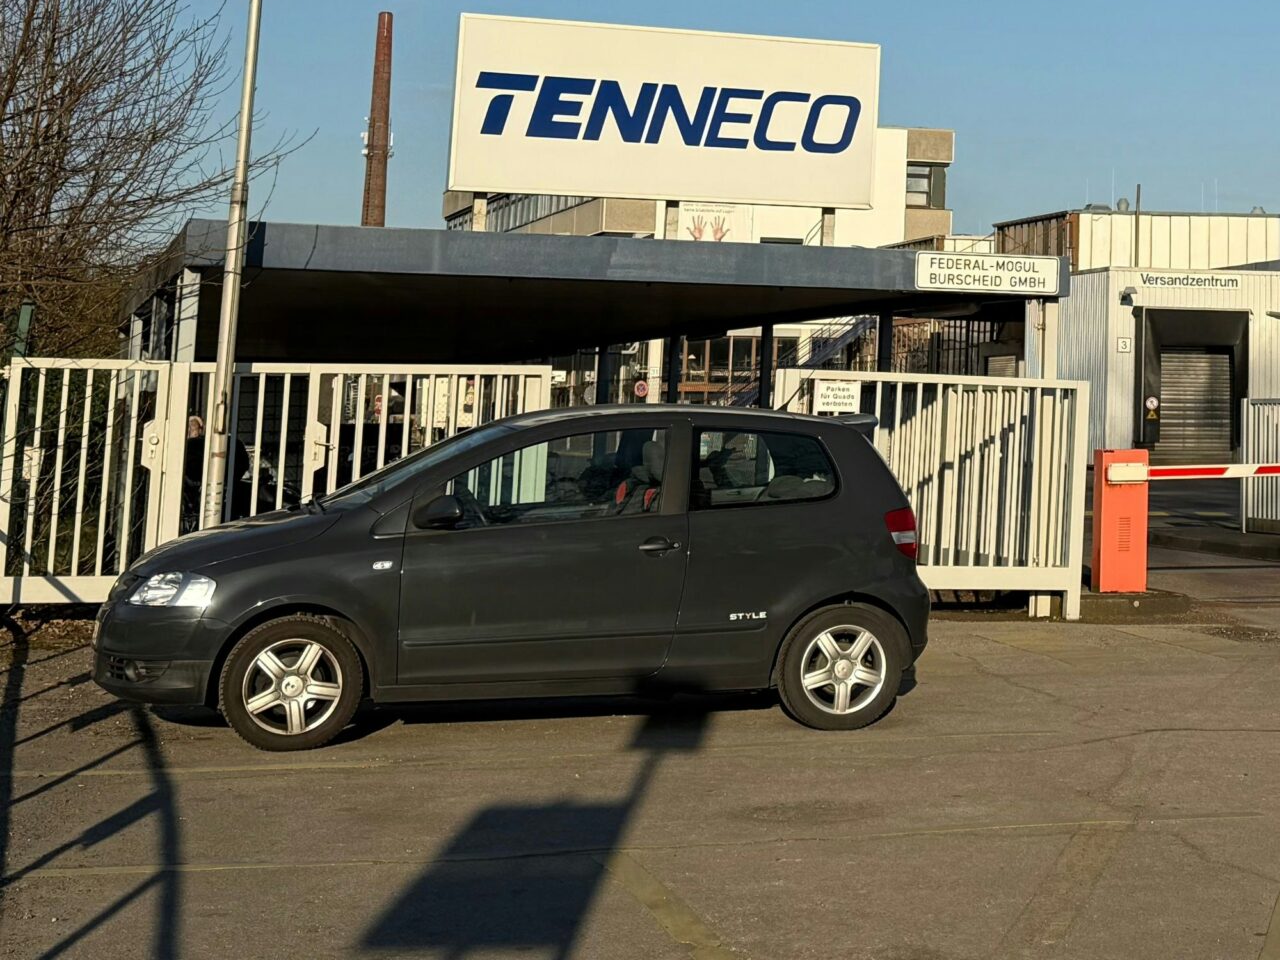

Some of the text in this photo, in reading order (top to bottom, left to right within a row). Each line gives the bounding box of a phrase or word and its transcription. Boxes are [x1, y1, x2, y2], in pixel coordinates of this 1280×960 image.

[475, 71, 861, 154] TENNECO
[930, 257, 1039, 273] FEDERAL-MOGUL
[929, 273, 1046, 289] BURSCHEID GMBH
[1140, 273, 1239, 288] Versandzentrum
[1121, 340, 1128, 350] 3
[729, 611, 767, 621] STYLE
